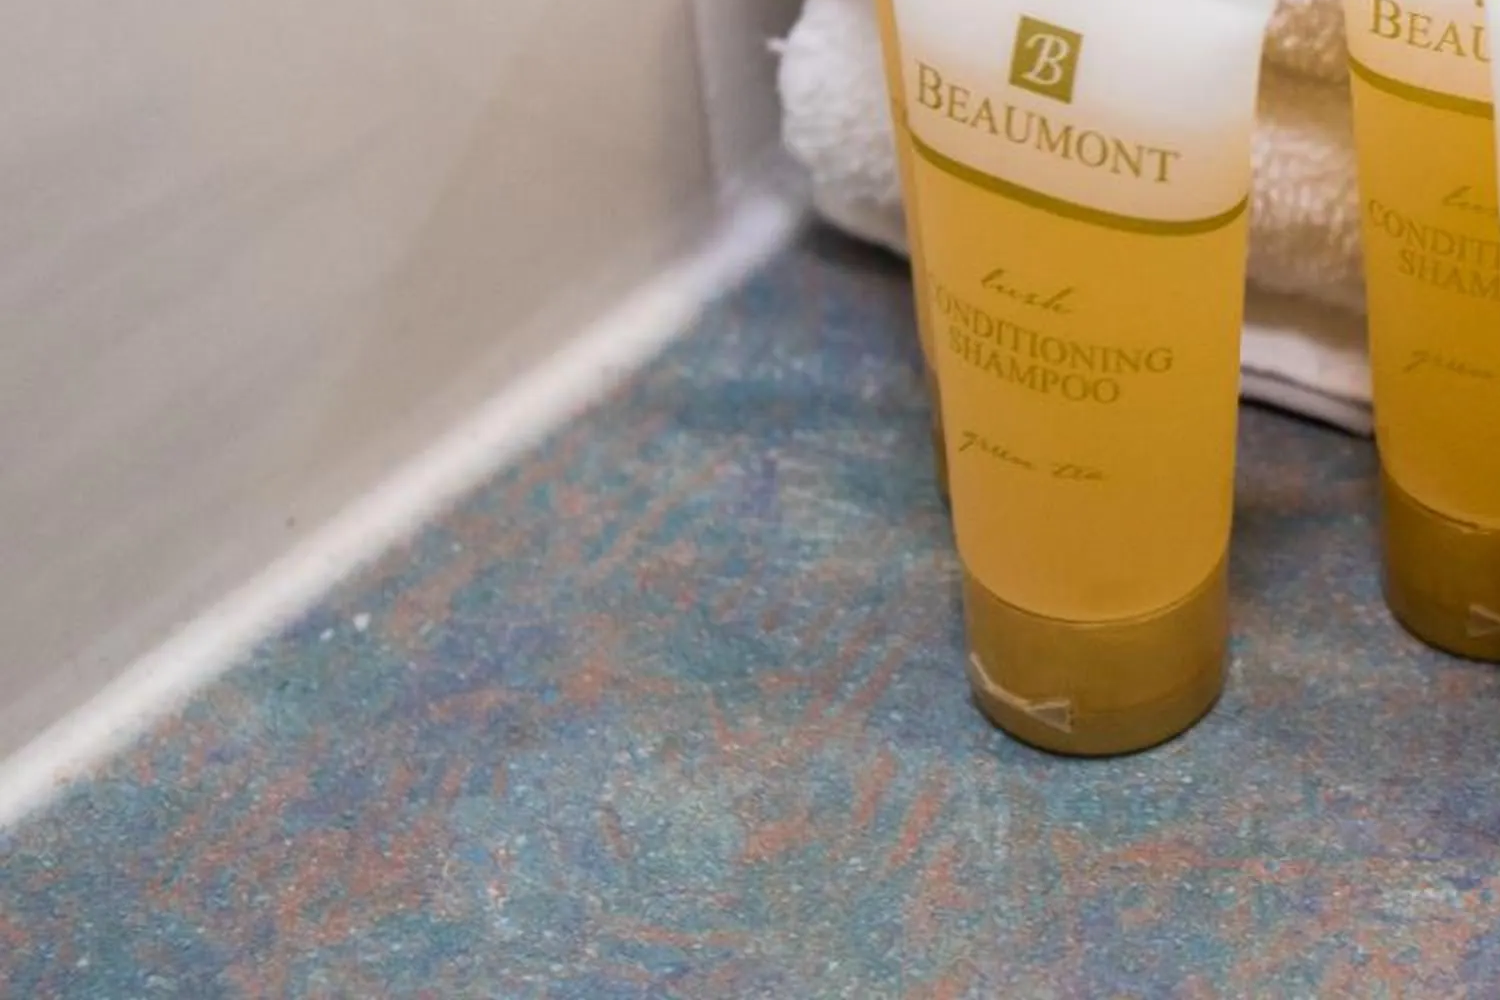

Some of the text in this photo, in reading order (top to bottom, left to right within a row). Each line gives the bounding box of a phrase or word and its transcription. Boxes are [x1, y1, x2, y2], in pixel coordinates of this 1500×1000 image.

[1019, 30, 1073, 89] B
[915, 60, 1182, 184] BEAUMONT
[1369, 199, 1500, 271] CONDITI
[935, 284, 1174, 374] ONDITIONING
[948, 324, 1121, 404] SHAMPOO
